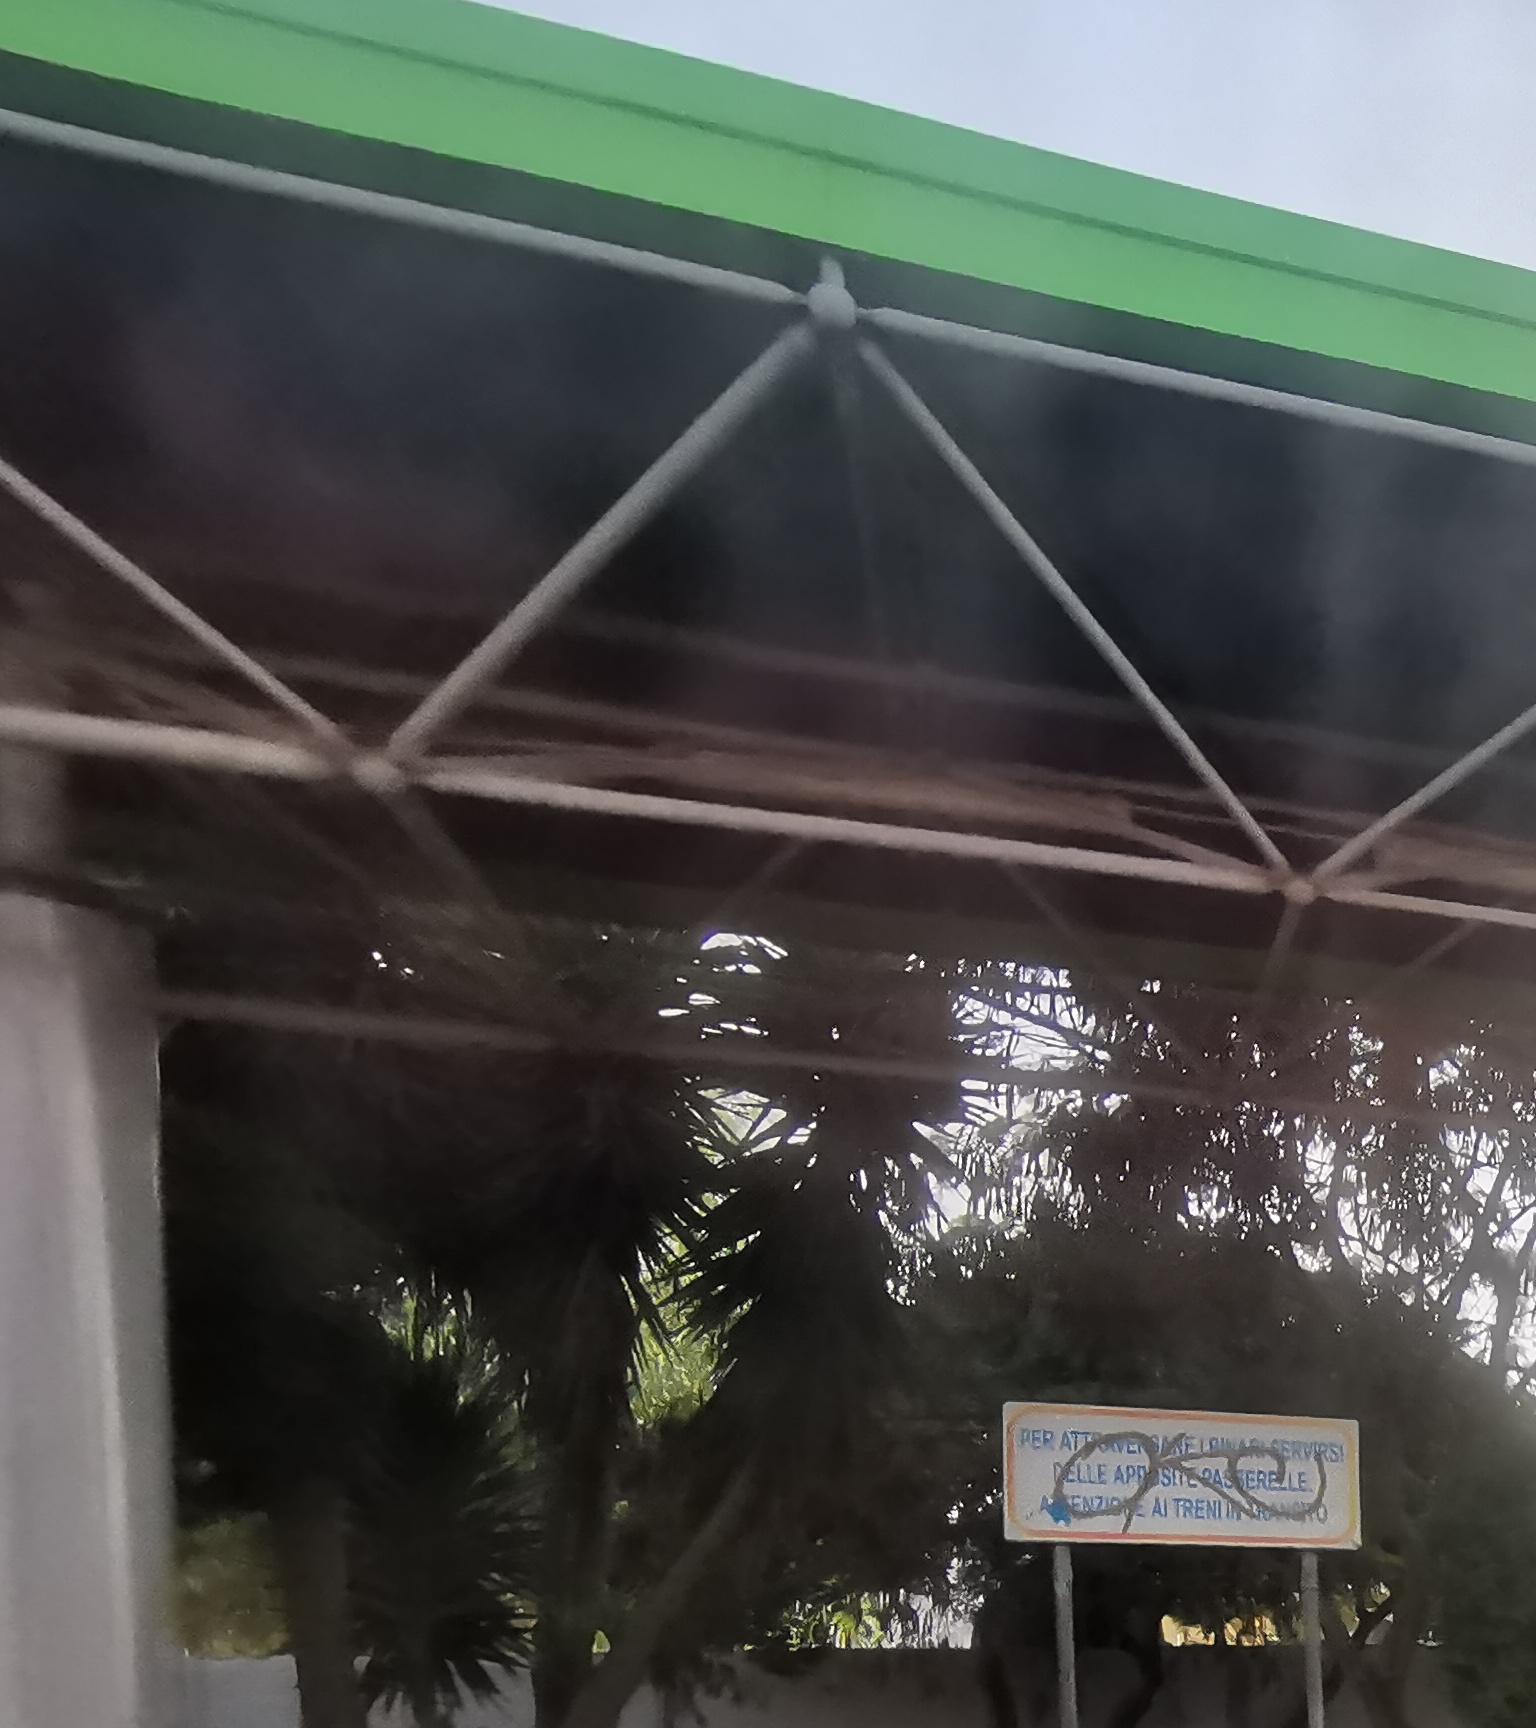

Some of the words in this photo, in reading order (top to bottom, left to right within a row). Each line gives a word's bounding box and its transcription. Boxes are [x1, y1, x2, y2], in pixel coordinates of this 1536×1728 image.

[1114, 1465, 1198, 1489] APPSITE
[1040, 1494, 1145, 1518] AENZIOE
[1152, 1496, 1168, 1518] AI
[1172, 1497, 1222, 1521] TRENI
